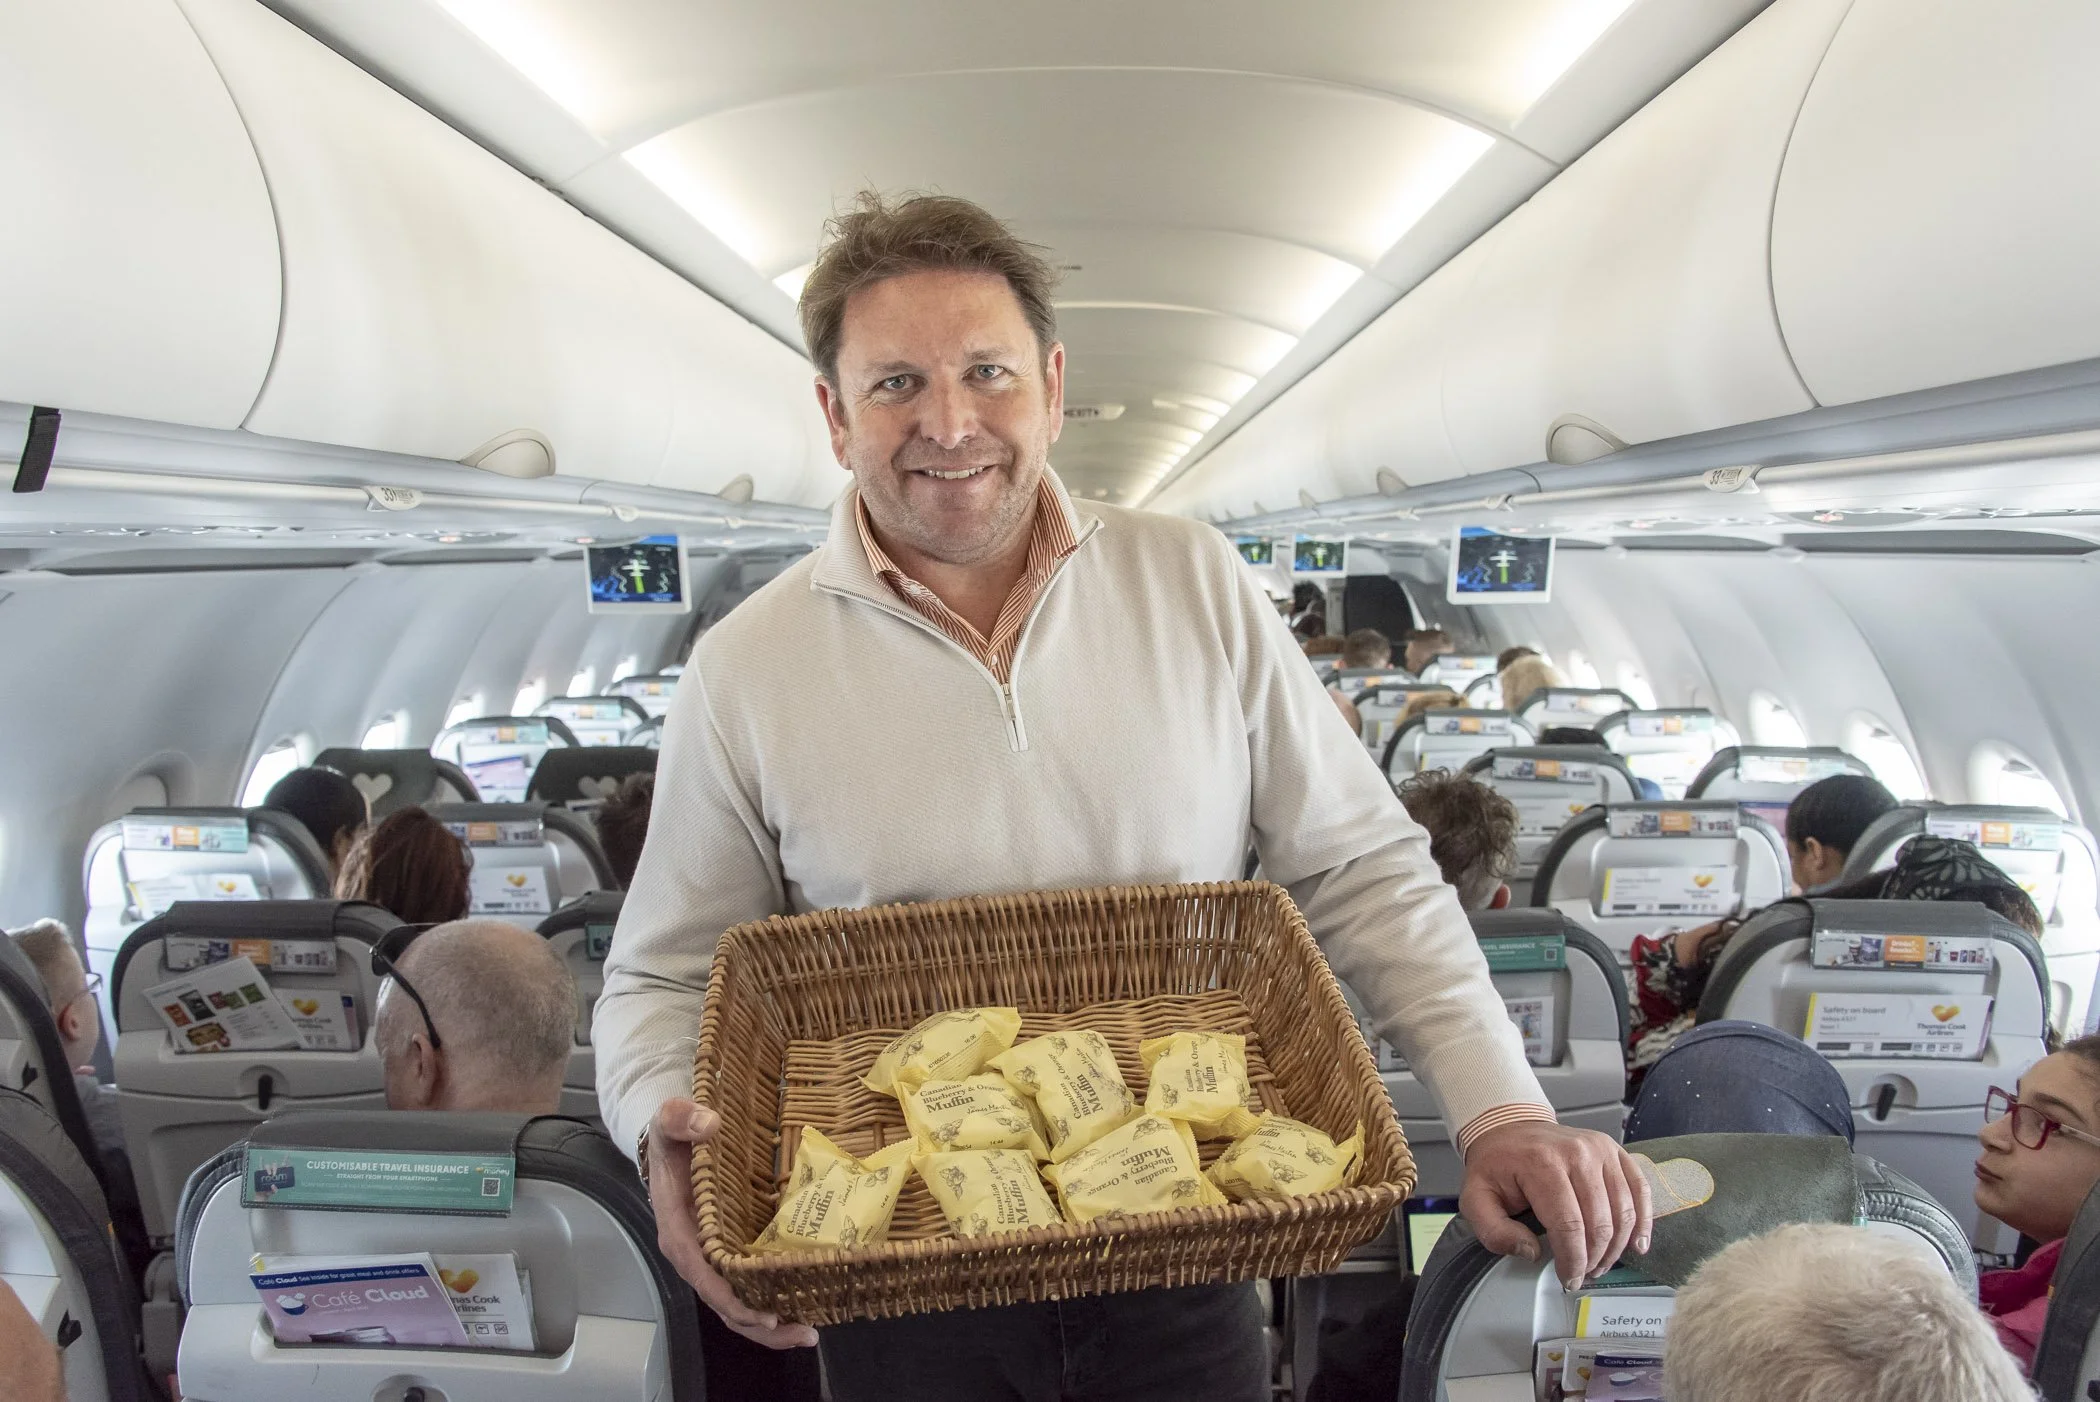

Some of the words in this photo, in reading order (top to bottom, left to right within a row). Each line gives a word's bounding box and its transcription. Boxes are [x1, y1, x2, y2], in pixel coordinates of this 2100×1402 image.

[1947, 1023, 1967, 1031] Cook
[920, 1083, 962, 1097] Canadian
[1202, 1066, 1218, 1094] Muffin
[922, 1087, 966, 1104] Blueberry
[968, 1084, 975, 1092] &
[1060, 1083, 1081, 1119] Canadian
[1070, 1081, 1092, 1116] Blueberry
[1077, 1074, 1104, 1113] Muffin
[926, 1095, 976, 1113] Muffin
[1121, 1146, 1172, 1167] Muffin
[1130, 1156, 1175, 1175] Blueberry
[306, 1160, 377, 1172] CUSTOMISABLE
[379, 1163, 412, 1174] TRAVEL
[414, 1164, 469, 1175] INSURANCE
[1121, 1172, 1129, 1180] &
[1135, 1165, 1178, 1185] Canadian
[1087, 1179, 1120, 1197] Orange
[786, 1190, 809, 1234] Canadian
[991, 1183, 1005, 1224] Canadian
[1001, 1182, 1015, 1224] Blueberry
[1009, 1180, 1029, 1224] Muffin
[796, 1190, 821, 1237] Blueberry
[806, 1190, 835, 1241] Muffin
[276, 1276, 298, 1285] Cloud
[311, 1289, 361, 1308] Café
[365, 1285, 431, 1302] Cloud
[473, 1295, 501, 1304] Cook
[454, 1304, 487, 1312] irlines
[1601, 1315, 1643, 1327] Safety
[1645, 1317, 1662, 1326] on
[1600, 1330, 1628, 1338] Airbus
[1631, 1330, 1656, 1338] A321
